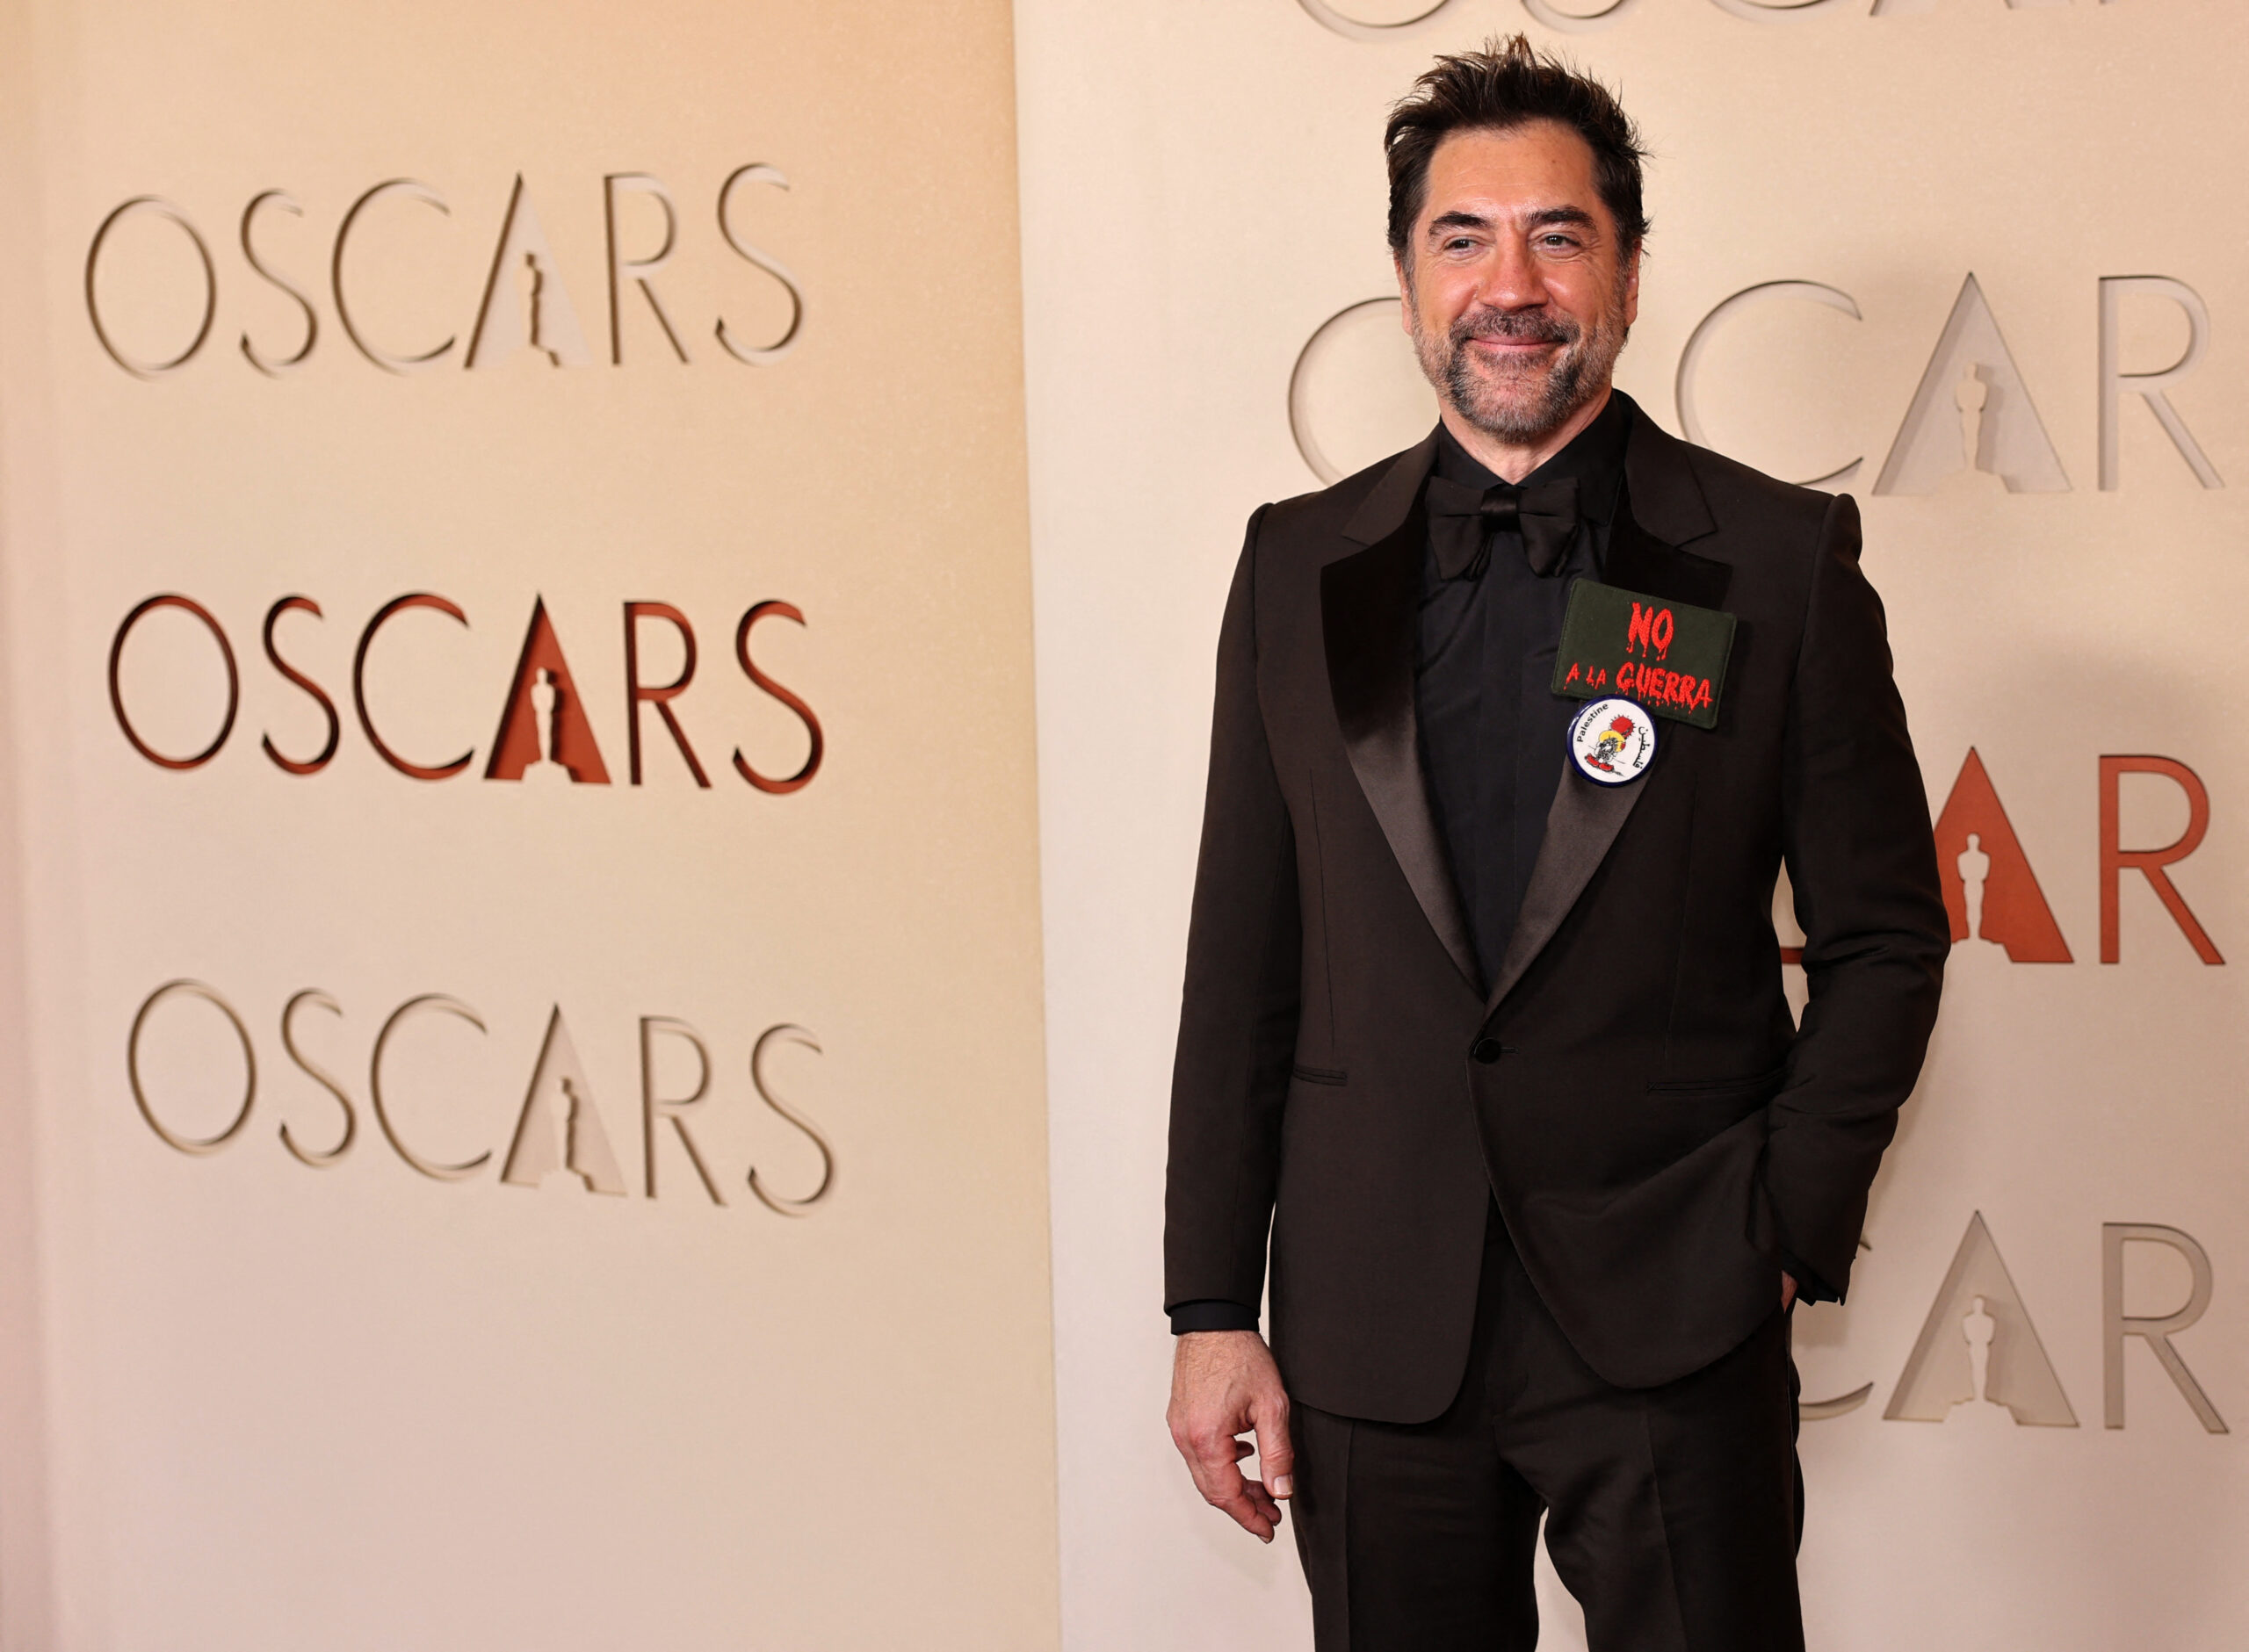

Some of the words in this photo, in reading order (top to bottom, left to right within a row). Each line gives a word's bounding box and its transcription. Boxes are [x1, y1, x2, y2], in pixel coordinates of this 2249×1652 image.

[84, 162, 807, 379] OSCARS
[1626, 602, 1674, 660] NO
[107, 590, 825, 795] OSCARS
[1564, 662, 1580, 689] A
[1586, 666, 1608, 689] LA
[1616, 661, 1713, 713] GUERRA
[1576, 703, 1609, 743] Palestine
[1632, 725, 1651, 769] فلسطين
[127, 978, 836, 1219] OSCARS
